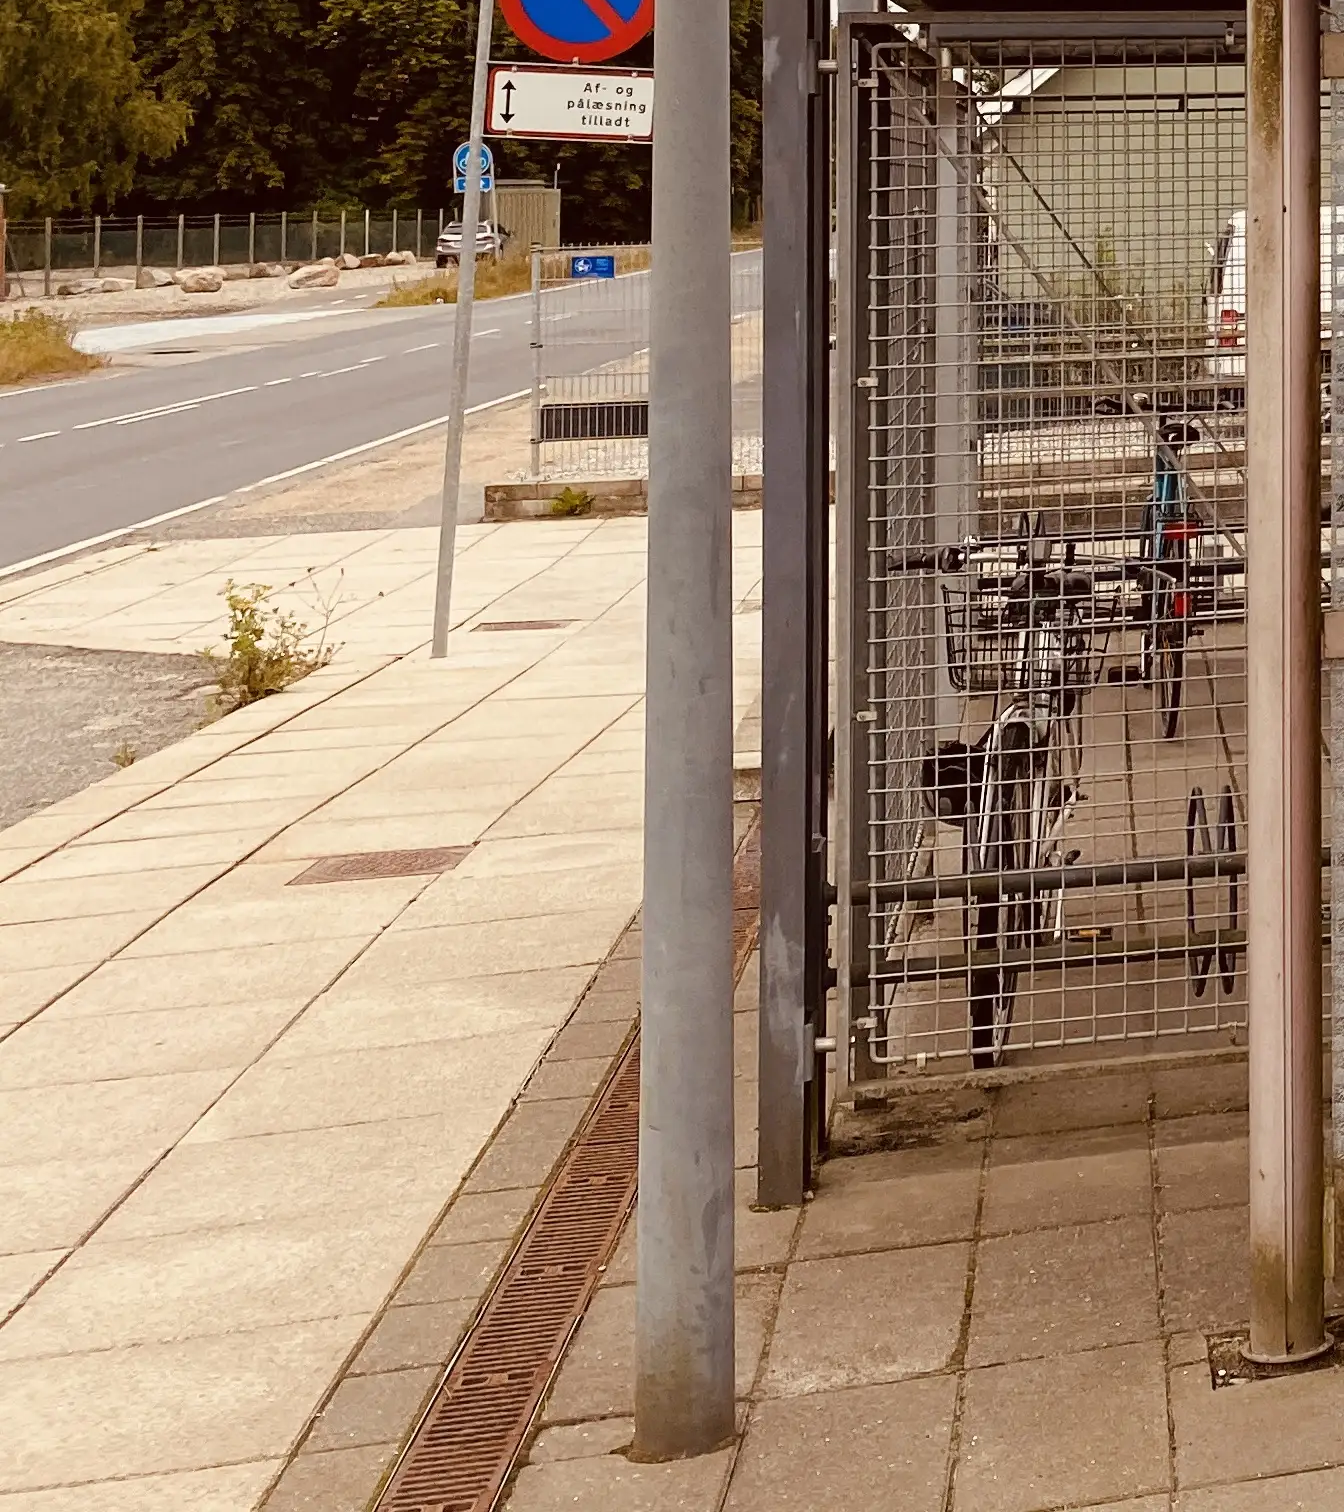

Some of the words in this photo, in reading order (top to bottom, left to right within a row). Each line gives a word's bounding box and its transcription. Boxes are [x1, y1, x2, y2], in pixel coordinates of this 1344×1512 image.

[583, 82, 607, 94] Af-
[615, 86, 633, 97] og
[567, 98, 646, 114] pålæsning
[581, 115, 630, 127] tilladt
